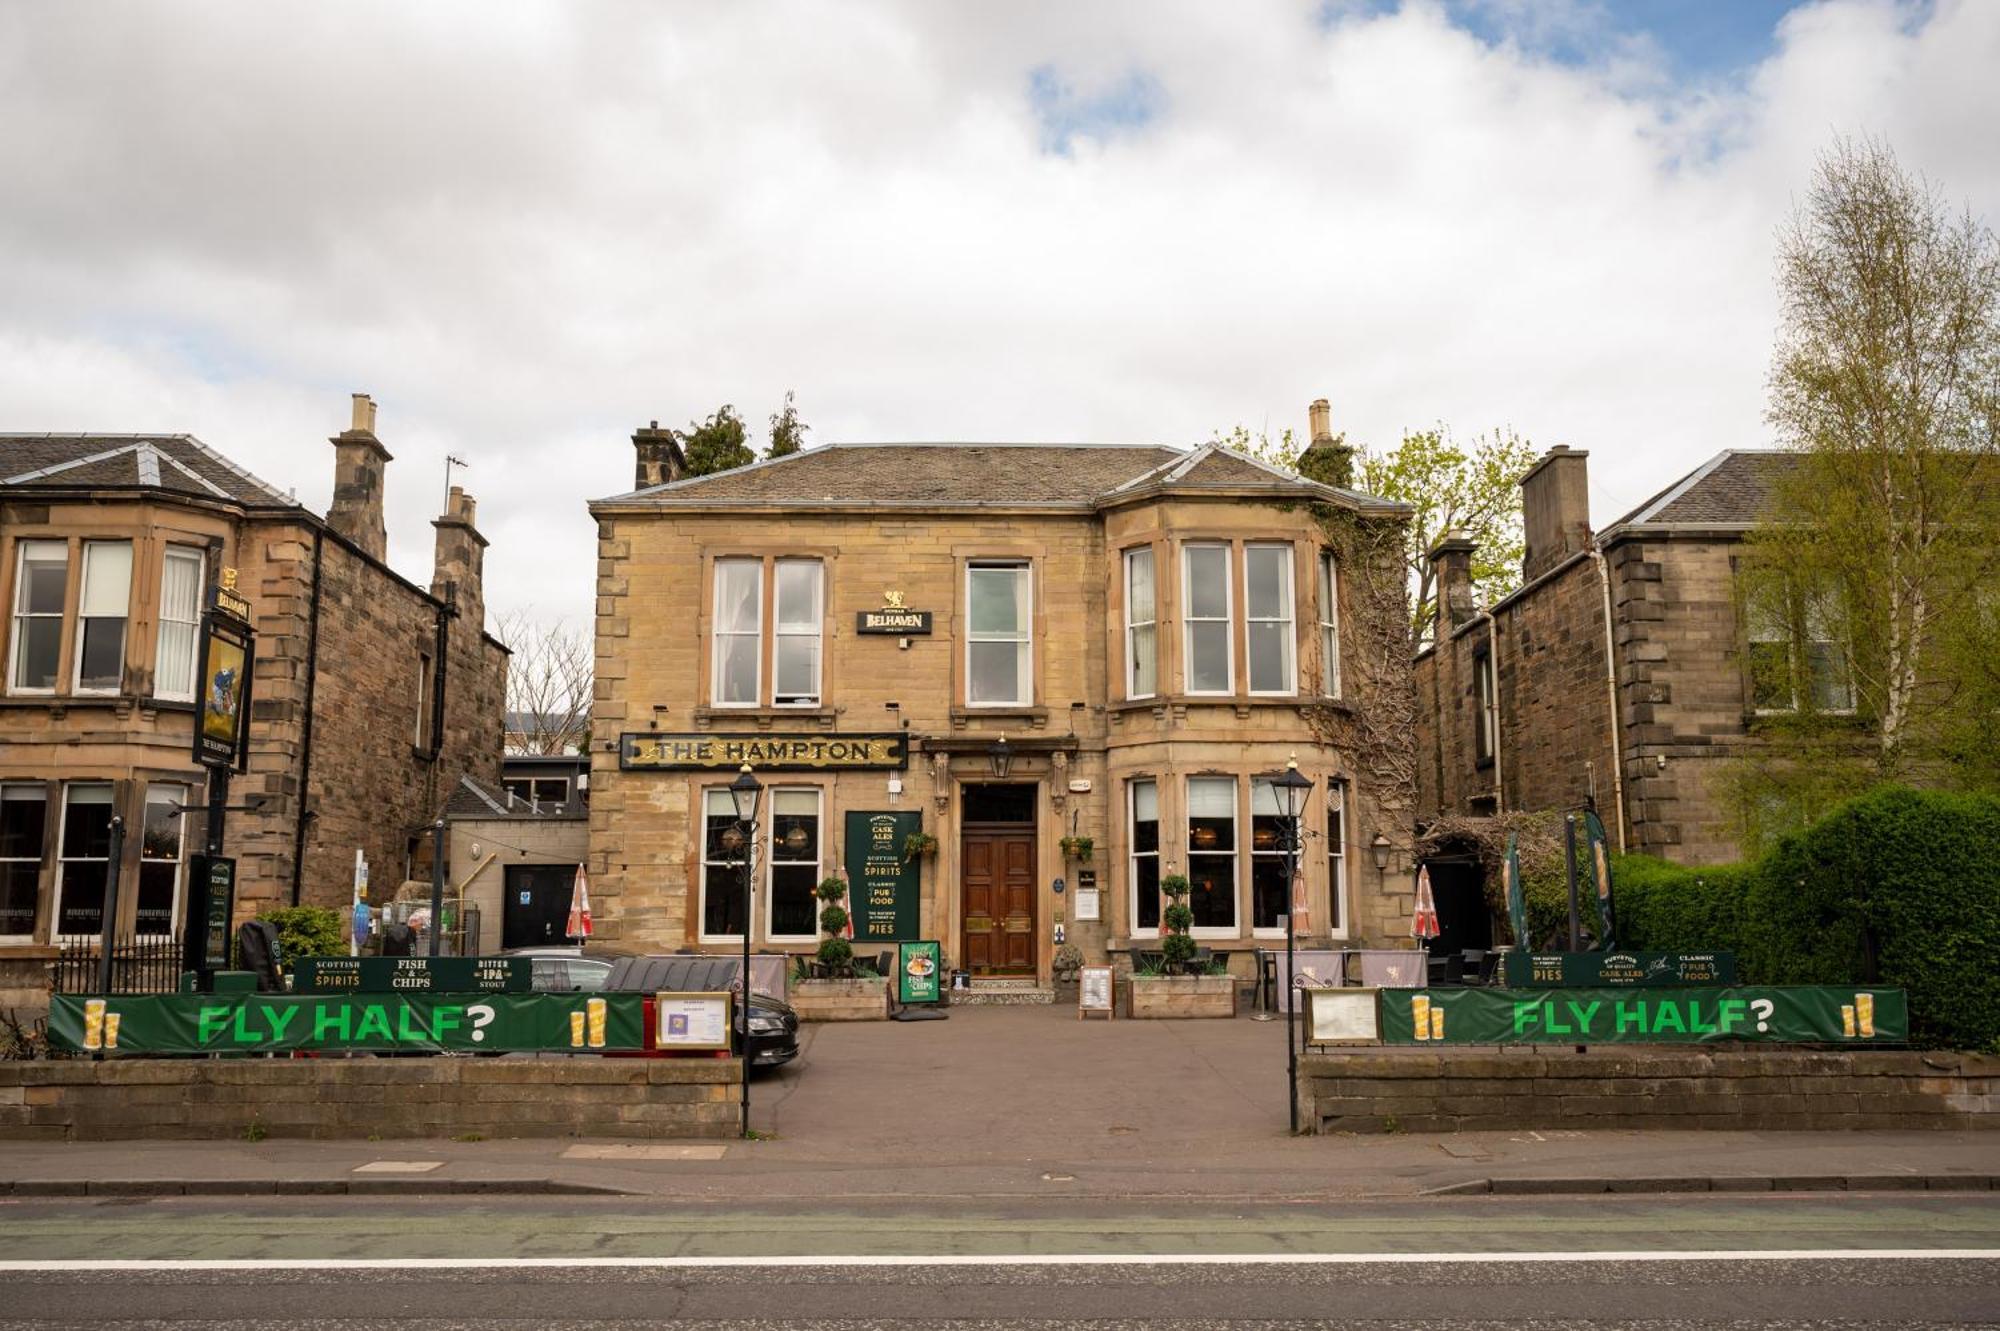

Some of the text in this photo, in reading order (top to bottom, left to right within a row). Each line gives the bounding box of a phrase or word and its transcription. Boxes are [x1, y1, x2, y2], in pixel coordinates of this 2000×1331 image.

[866, 614, 922, 628] BELHAVEN
[657, 742, 871, 760] THE HAMPTON
[864, 867, 901, 876] SPIRITS
[873, 888, 890, 896] PUB
[870, 897, 894, 905] FOOD
[868, 924, 895, 934] PIES
[316, 961, 360, 969] SCOTTISH
[398, 960, 427, 969] FISH
[478, 960, 509, 968] BITTER
[483, 969, 503, 980] IPA
[1534, 970, 1562, 981] PIES
[315, 976, 360, 986] SPIRITS
[392, 978, 431, 988] CHIPS
[1514, 998, 1774, 1034] FLY HALF?
[199, 1004, 496, 1042] FLY HALF?
